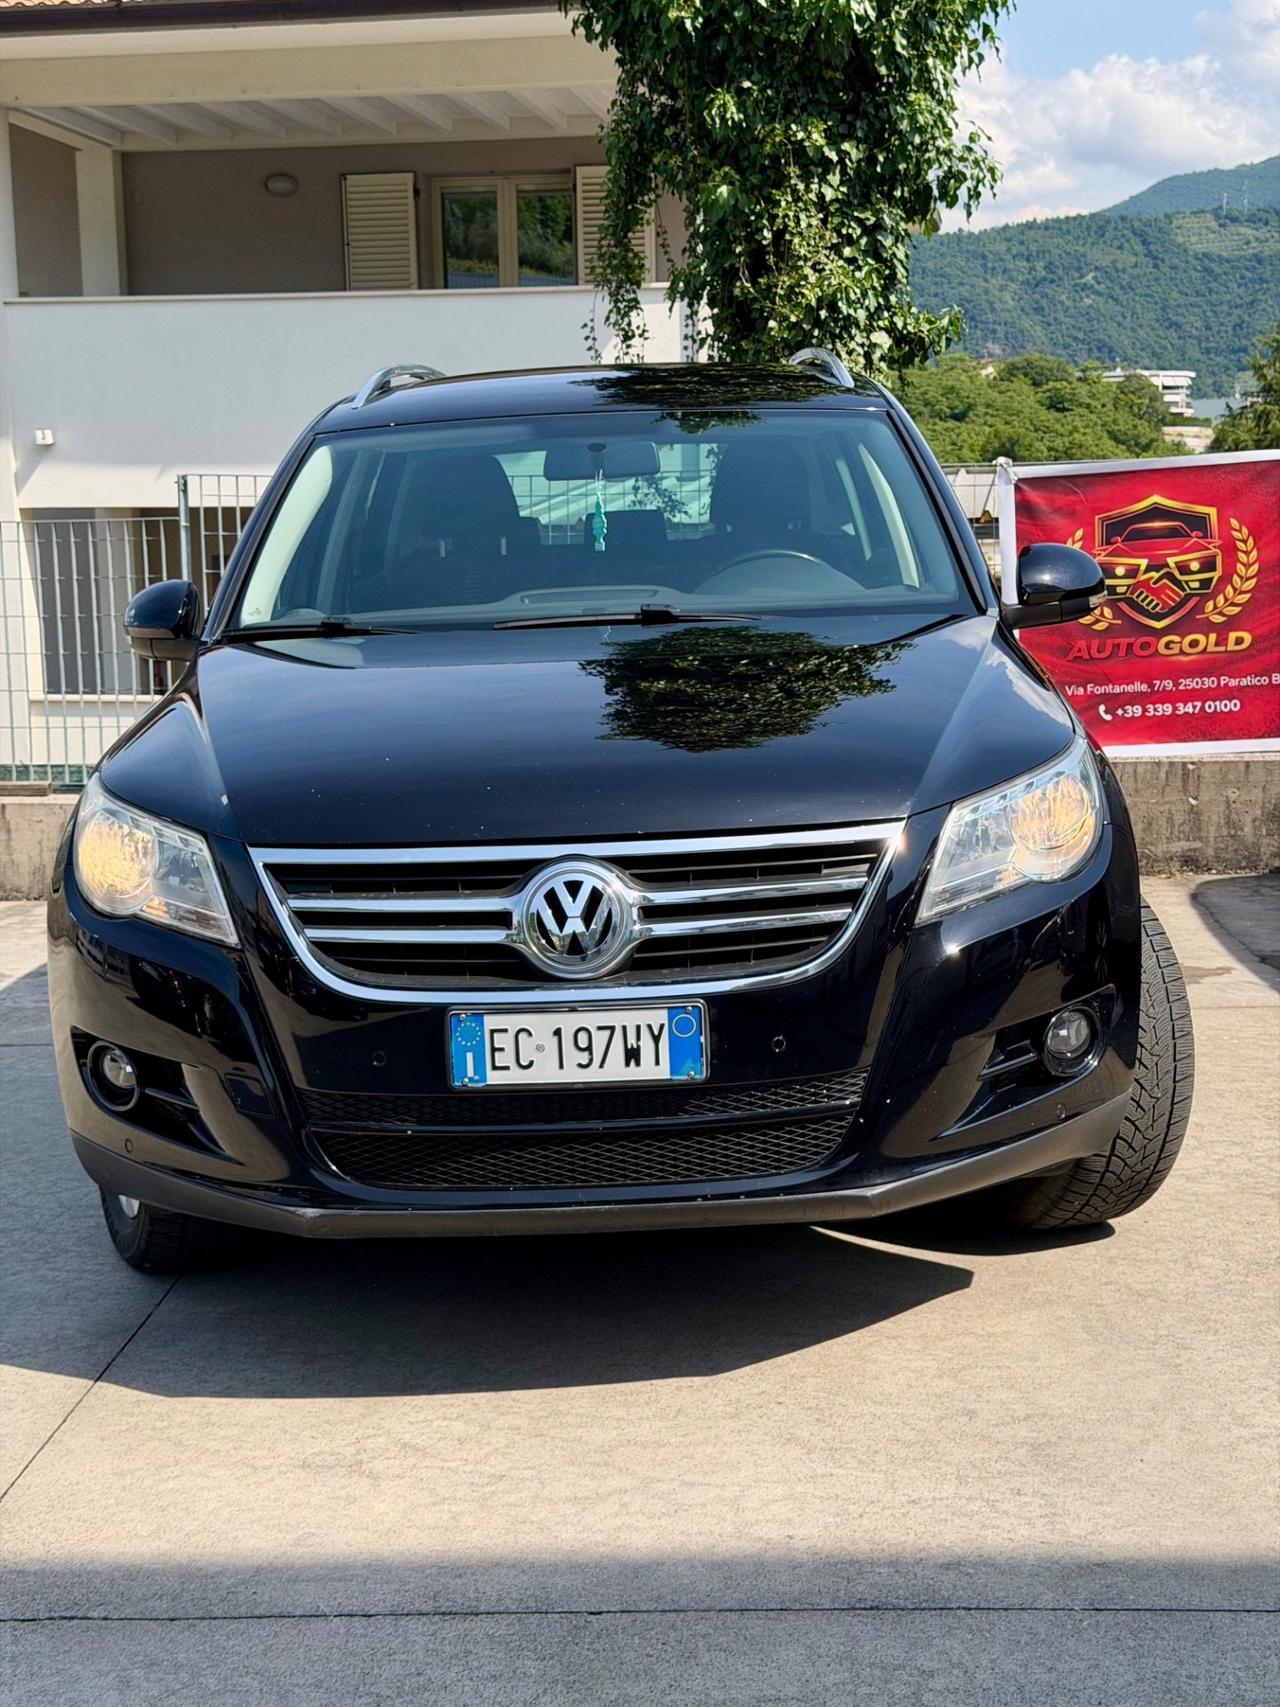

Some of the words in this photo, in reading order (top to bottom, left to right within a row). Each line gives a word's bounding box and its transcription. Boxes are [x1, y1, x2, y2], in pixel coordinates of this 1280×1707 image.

[1066, 631, 1252, 661] AUTOGOLD
[1065, 684, 1084, 696] Via
[1087, 681, 1151, 696] Fontanelle,
[1153, 679, 1176, 692] 7/9,
[1179, 676, 1218, 690] 25030
[1220, 674, 1269, 688] Paratico
[1116, 704, 1142, 718] +39
[1145, 703, 1172, 717] 339
[1175, 701, 1201, 715] 347
[1204, 699, 1241, 713] 0100
[525, 866, 618, 963] VW
[489, 1026, 535, 1072] EC
[552, 1022, 666, 1071] 197WY
